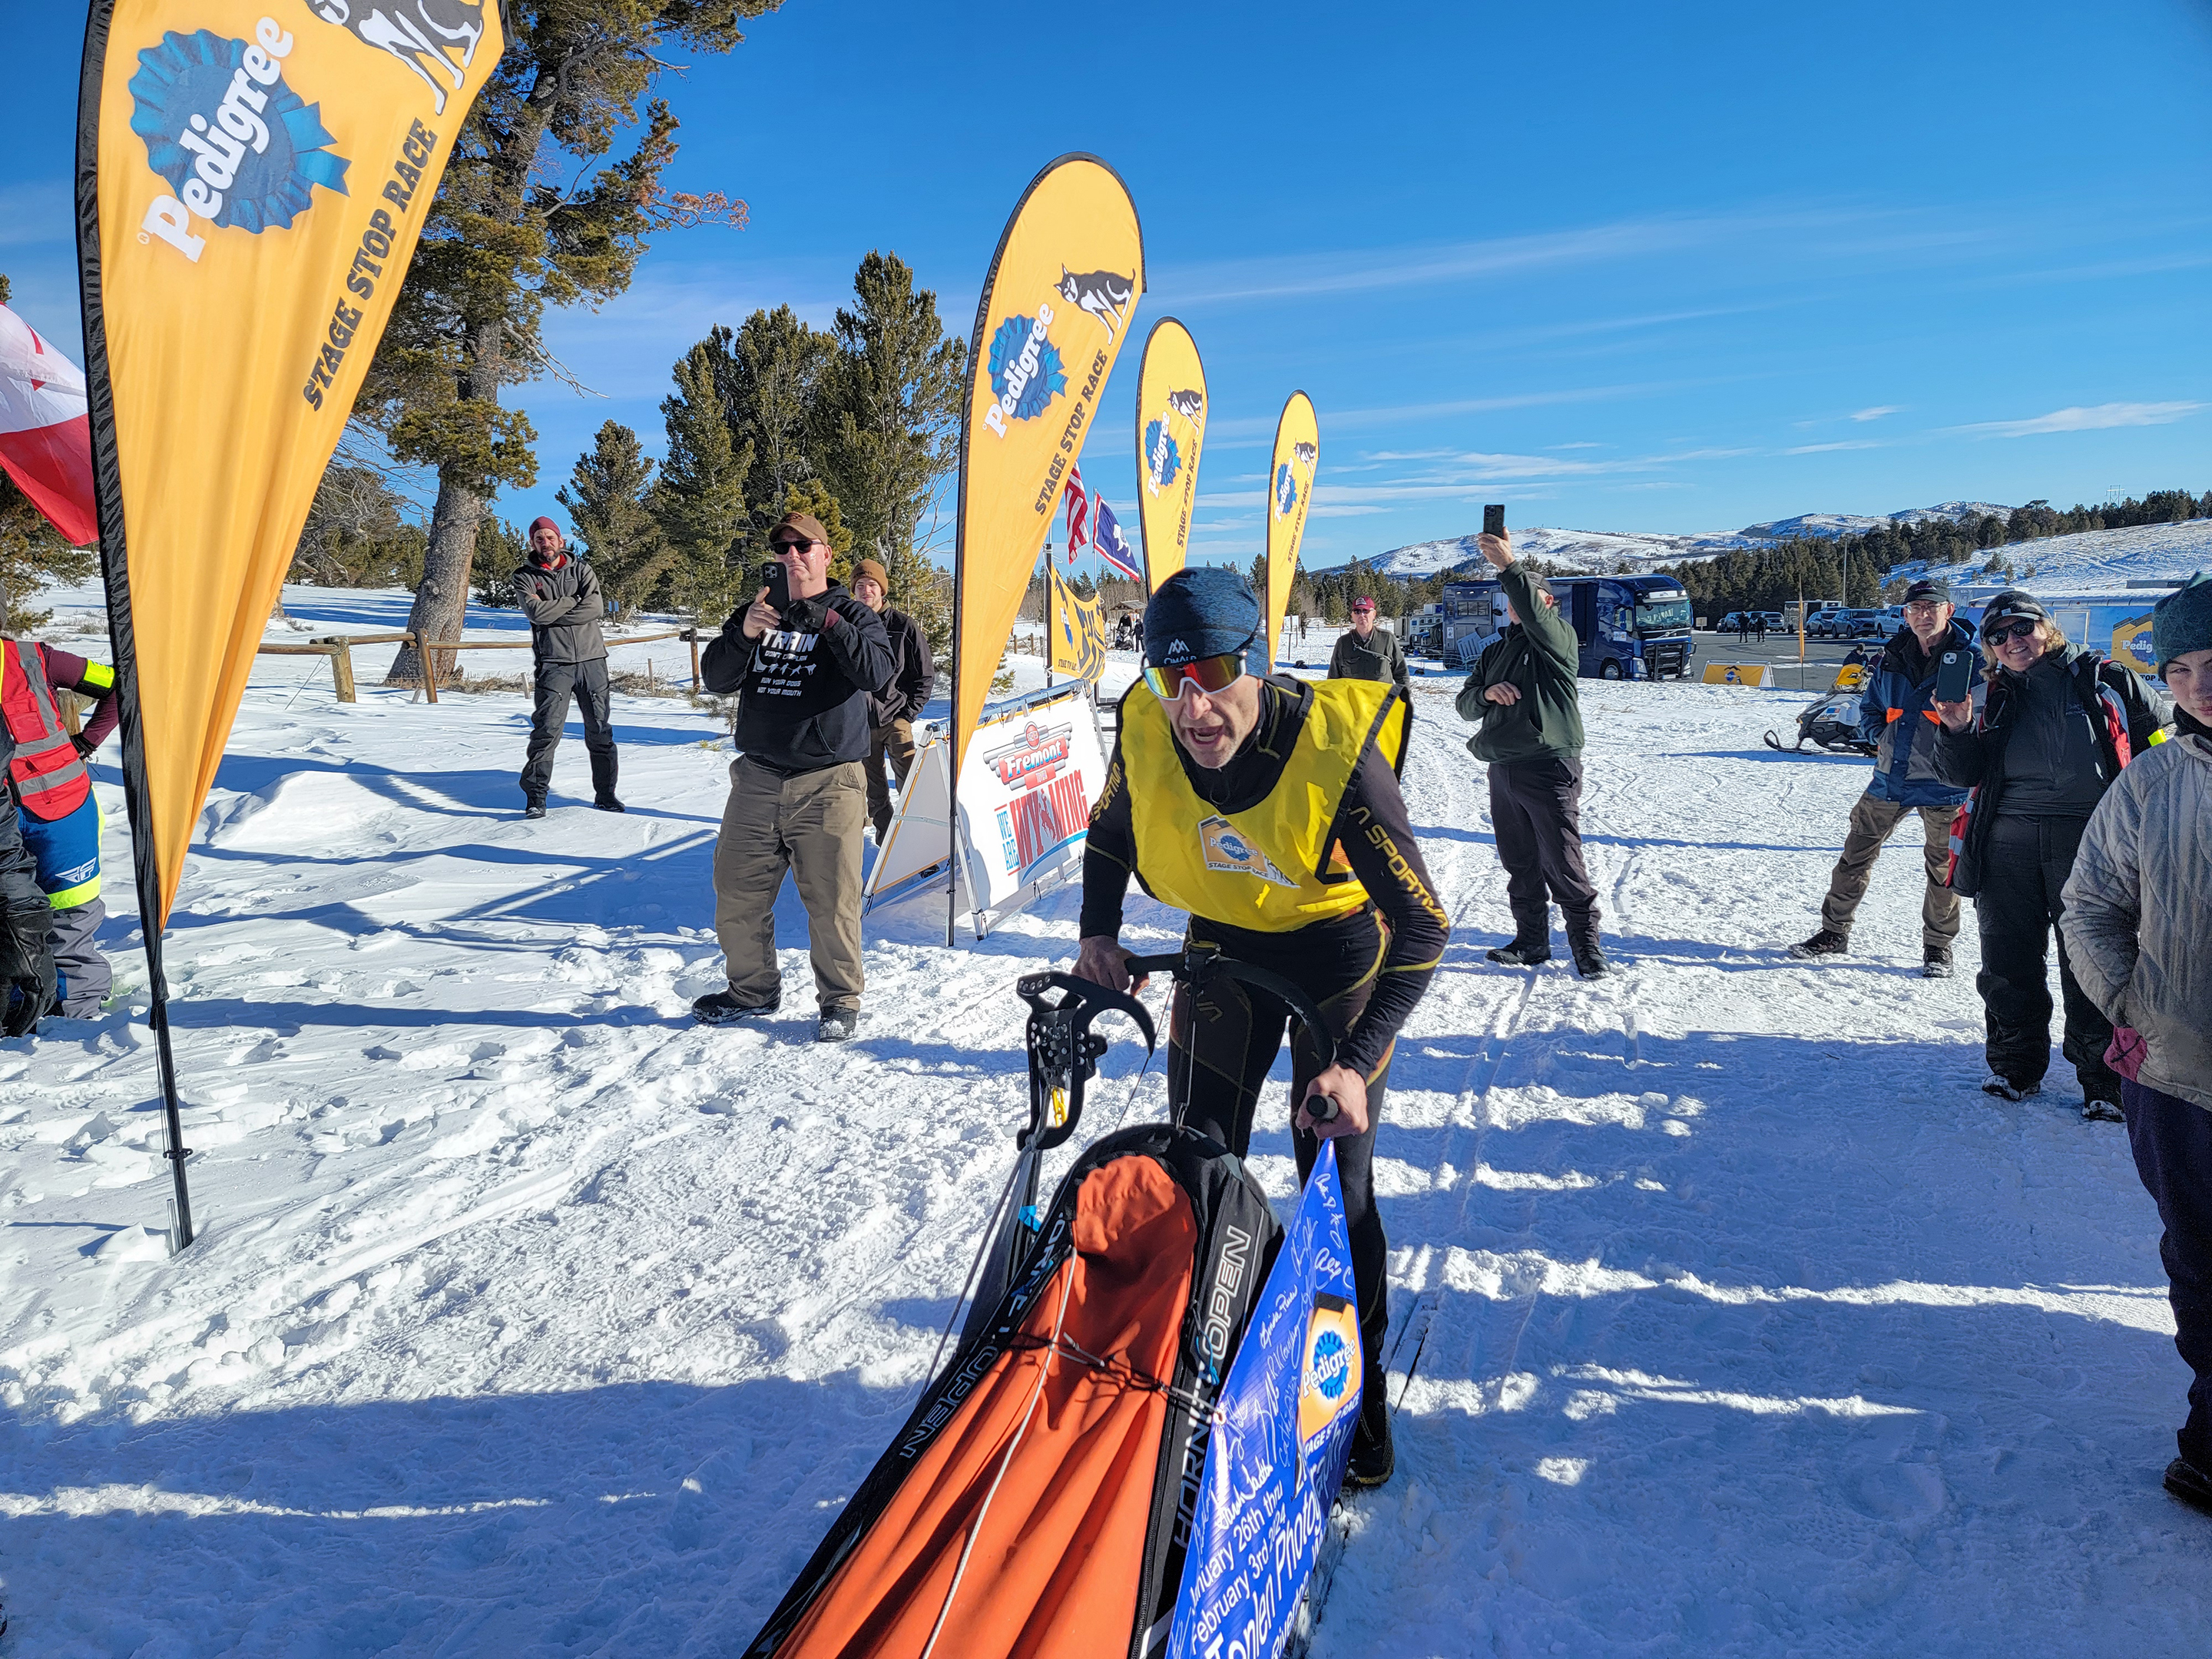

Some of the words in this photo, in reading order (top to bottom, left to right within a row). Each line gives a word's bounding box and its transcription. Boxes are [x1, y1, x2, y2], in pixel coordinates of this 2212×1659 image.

[142, 16, 293, 263] Pedigree
[303, 296, 364, 412] STAGE
[346, 210, 397, 300] STOP
[382, 117, 439, 214] RACE
[985, 303, 1055, 439] Pedigree
[1035, 452, 1067, 515] STAGE
[1060, 401, 1085, 454] STOP
[1081, 349, 1108, 403] RACE
[1147, 411, 1171, 498] Pedigree
[1188, 439, 1198, 474] RACE
[1184, 474, 1193, 507] STOP
[1275, 457, 1294, 523] Pedigree
[1177, 507, 1187, 548] STAGE
[1287, 531, 1297, 563] STAGE
[762, 628, 820, 652] TRAIN
[2121, 640, 2153, 653] Pedig
[1004, 740, 1063, 778] Fremont
[997, 810, 1012, 840] WE
[1002, 839, 1020, 872] ARE
[1209, 836, 1258, 856] Pedigree
[1252, 868, 1269, 878] RACE
[1201, 1224, 1251, 1360] OPEN
[1303, 1338, 1356, 1399] Pedigree
[1304, 1429, 1326, 1459] TAGE
[1190, 1541, 1234, 1615] Jnuary
[1233, 1507, 1265, 1553] 26th
[1263, 1479, 1283, 1515] thru
[1191, 1569, 1250, 1655] February
[1248, 1538, 1269, 1579] 3rd
[1268, 1502, 1286, 1553] 2024
